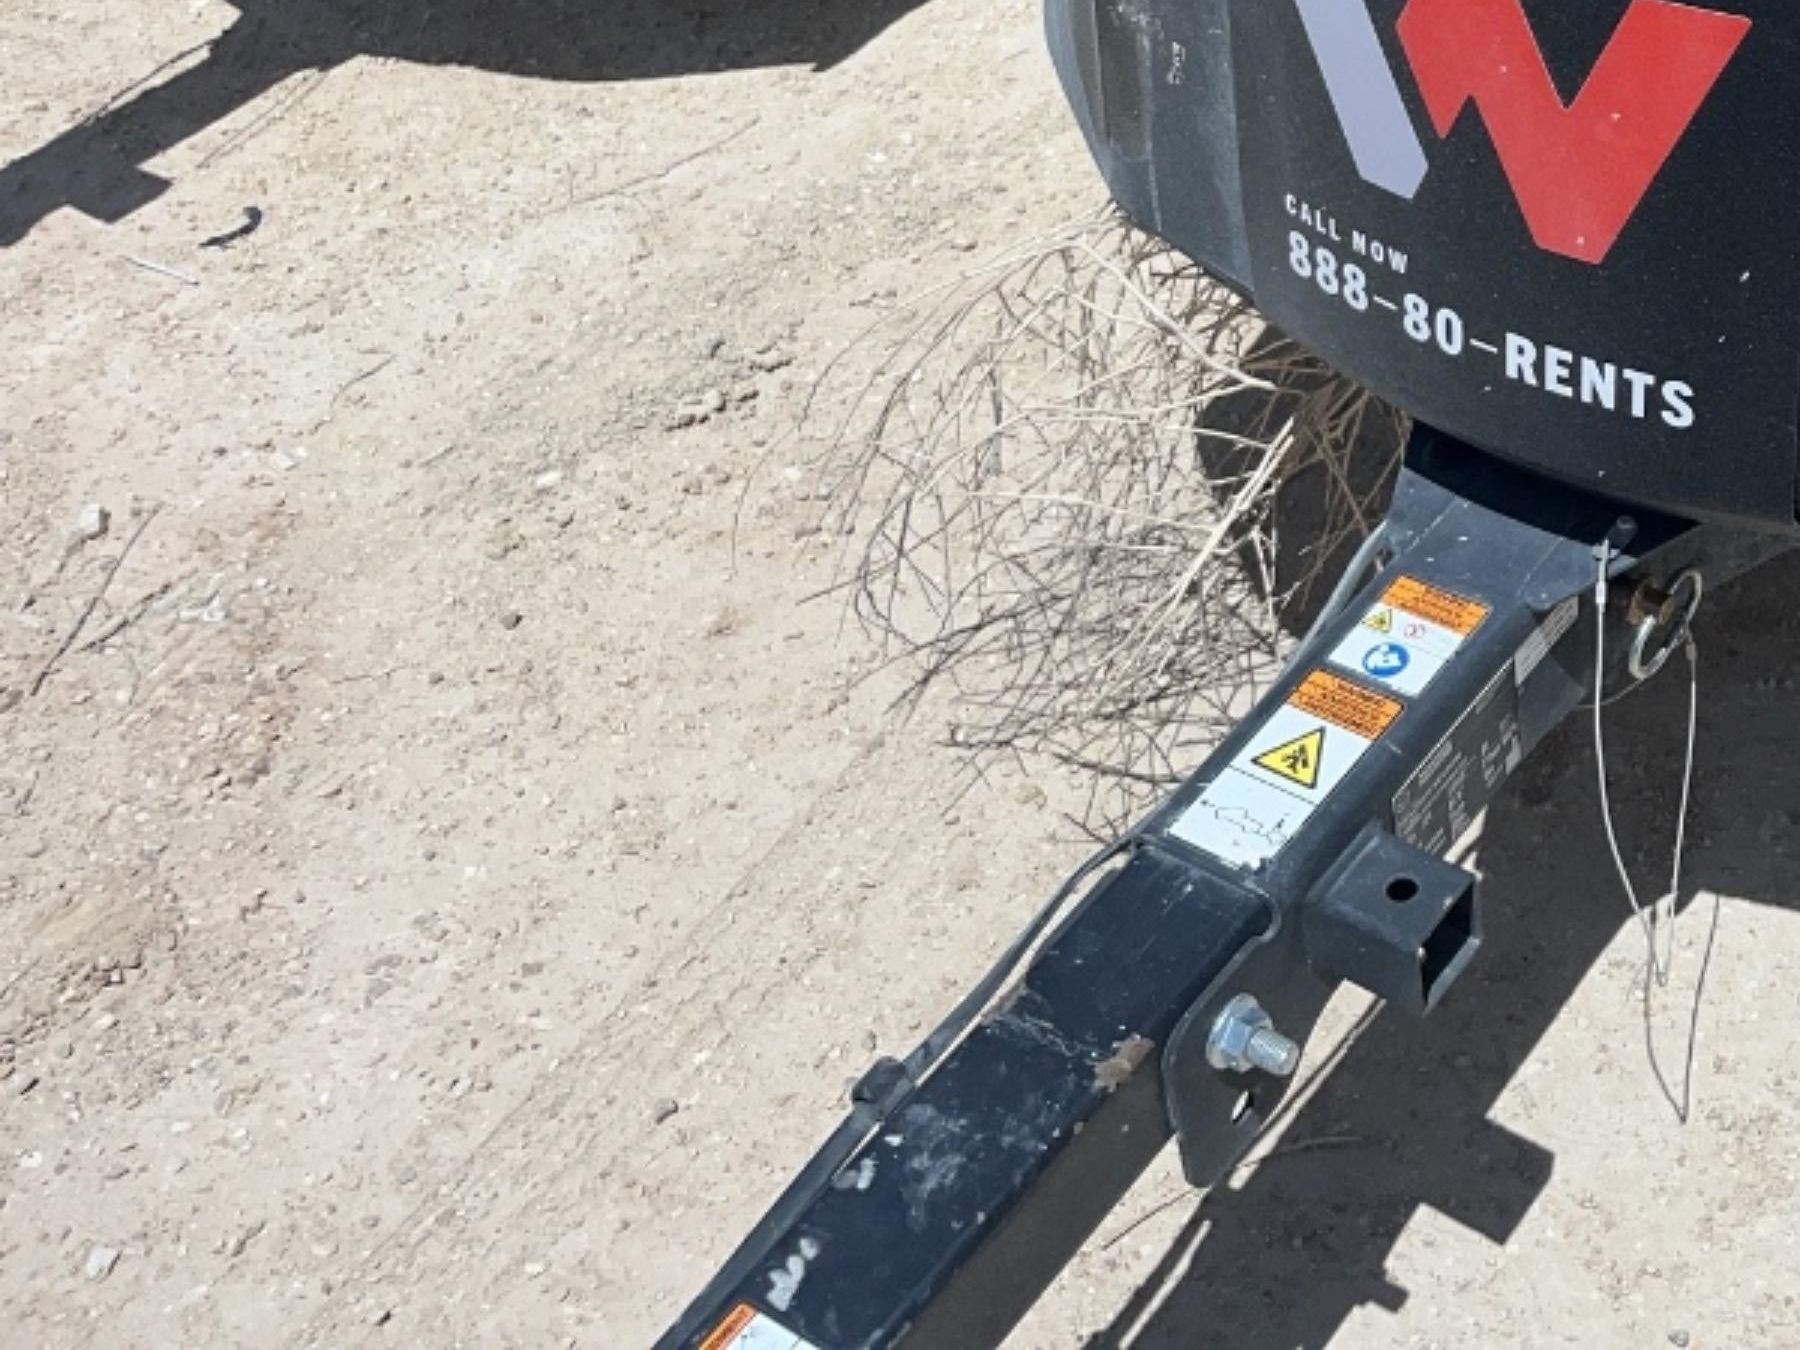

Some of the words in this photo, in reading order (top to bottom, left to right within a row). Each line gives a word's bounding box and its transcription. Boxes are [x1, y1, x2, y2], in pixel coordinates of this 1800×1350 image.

[1285, 193, 1341, 241] CALL
[1351, 229, 1408, 274] NOW
[1288, 230, 1696, 429] 888-80-RENTS
